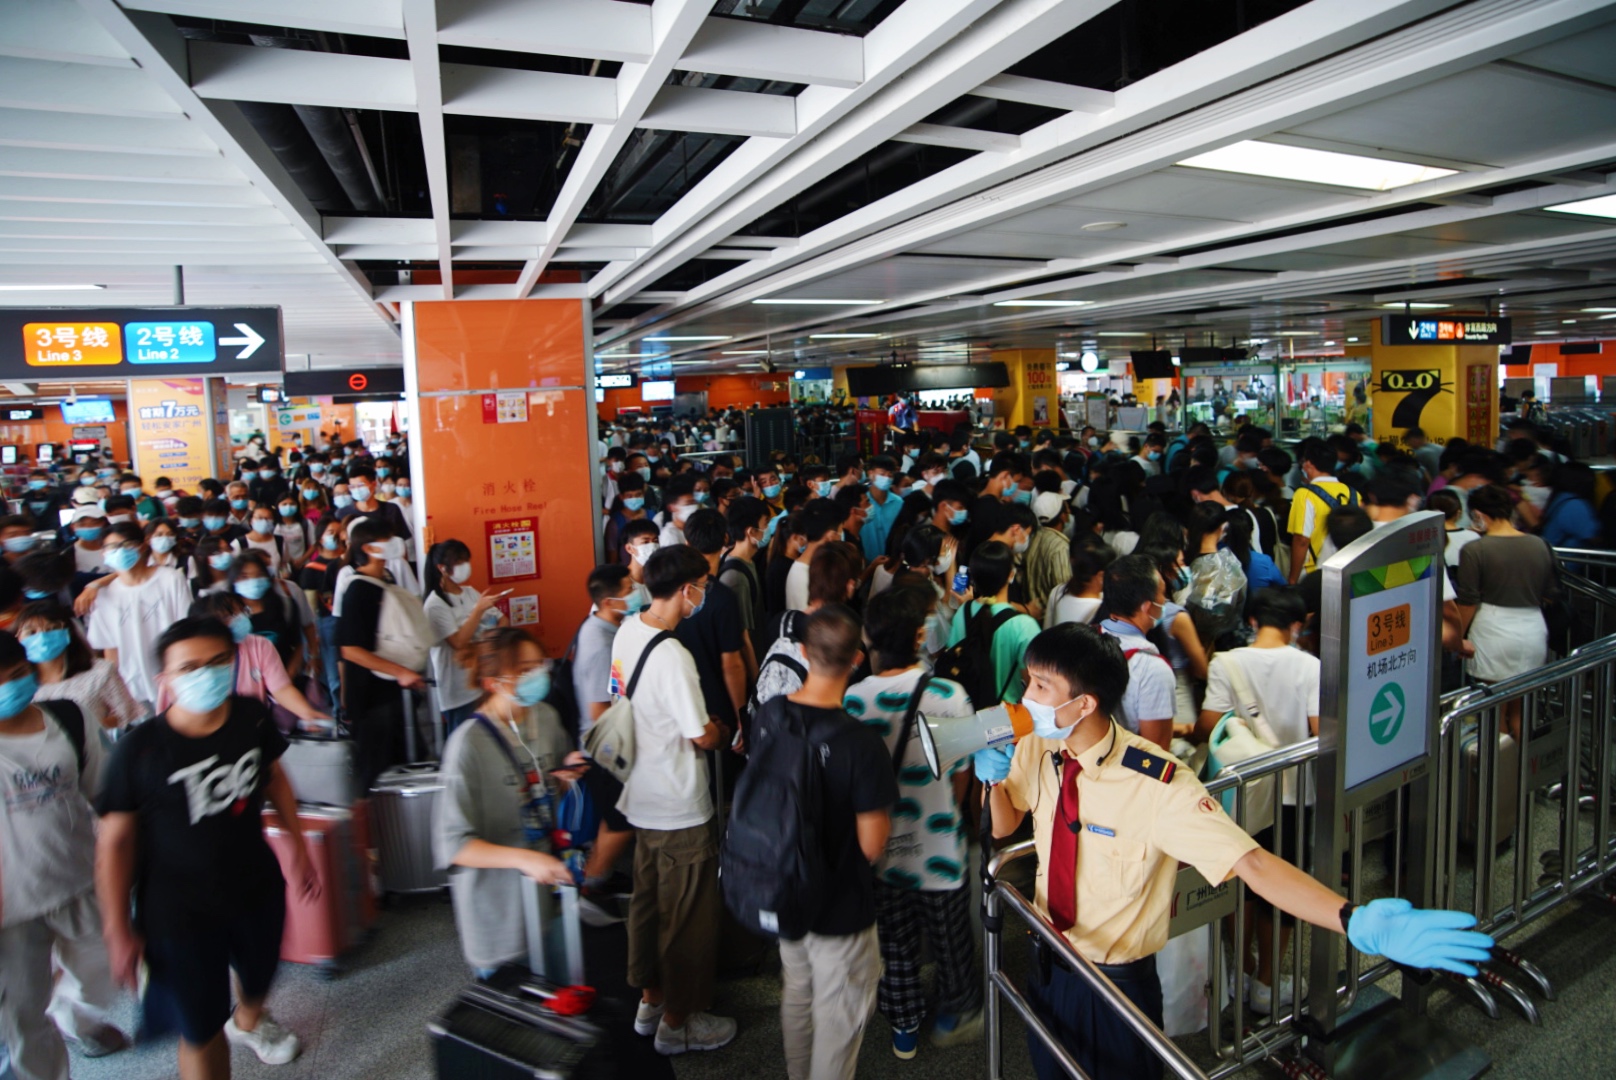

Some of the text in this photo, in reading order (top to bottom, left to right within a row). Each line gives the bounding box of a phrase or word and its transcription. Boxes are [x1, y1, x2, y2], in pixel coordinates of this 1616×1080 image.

[36, 326, 109, 348] 3号线
[136, 325, 204, 347] 2号线
[38, 349, 82, 362] Line 3
[138, 348, 179, 360] Line 2
[482, 478, 536, 496] 消火栓
[473, 501, 547, 515] Fire Hose Reel
[1371, 610, 1406, 637] 3号线
[1370, 634, 1394, 651] Line 3
[1367, 648, 1416, 679] 机场北方向
